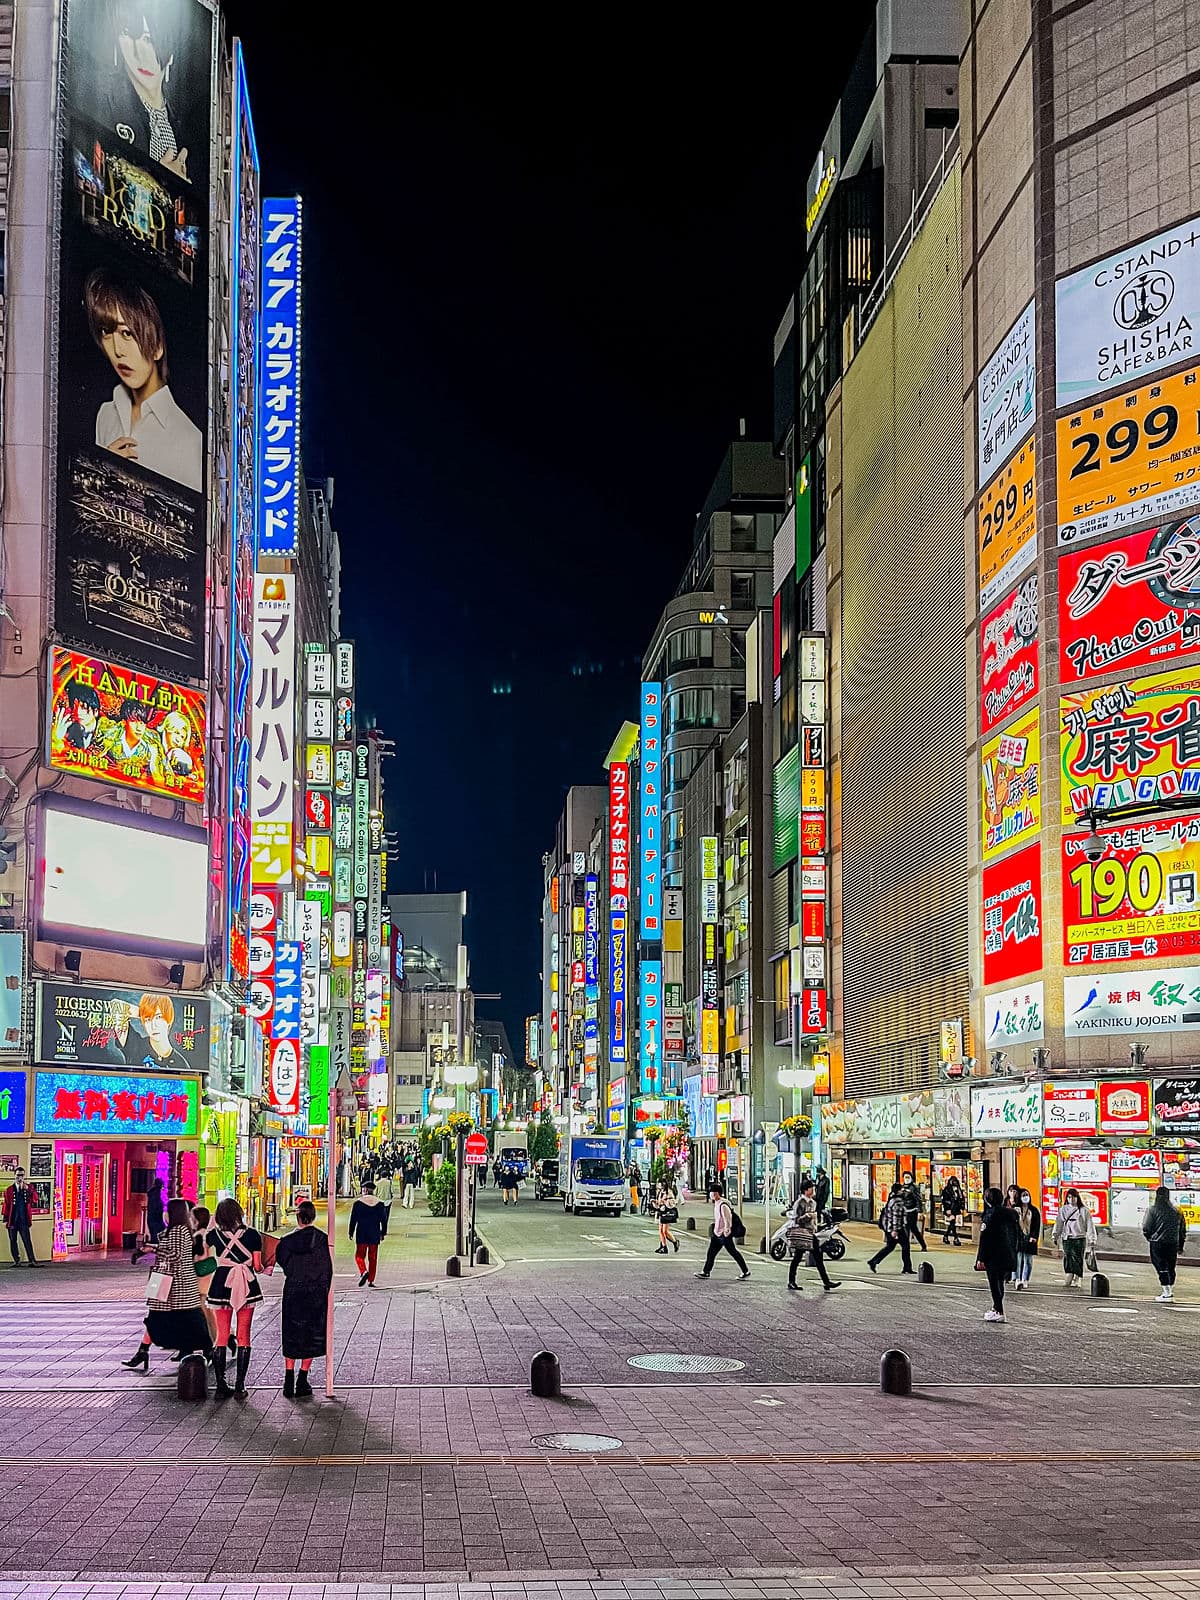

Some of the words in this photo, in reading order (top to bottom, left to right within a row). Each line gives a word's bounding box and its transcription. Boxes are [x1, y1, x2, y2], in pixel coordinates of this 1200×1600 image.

[265, 213, 295, 309] 747
[1097, 335, 1193, 382] CAFE&BAR
[1098, 315, 1193, 366] SHISHA
[982, 377, 1024, 441] シーシャ
[263, 322, 294, 538] カラオケランド
[1069, 404, 1179, 482] 299
[1073, 494, 1117, 516] 生ビール
[1128, 481, 1162, 497] サワー
[1113, 504, 1153, 524] 九十九
[254, 613, 291, 818] マルハン
[313, 700, 325, 736] にいむら
[1062, 683, 1137, 738] フリー&セット
[810, 728, 821, 759] ダーツ
[809, 770, 818, 804] 299円
[1007, 765, 1038, 807] 麻雀
[611, 767, 627, 890] カラオケ歌広場
[645, 693, 657, 930] カラオケ&パーティー館
[804, 823, 822, 850] 麻雀
[1070, 852, 1162, 918] 190
[1169, 872, 1195, 905] 円
[1127, 918, 1165, 934] 当日入会
[1070, 947, 1087, 961] 2F
[1092, 938, 1157, 959] 居酒屋一休
[274, 943, 300, 1038] カラオケ
[1108, 990, 1141, 1004] 焼肉
[183, 1004, 195, 1030] 山田
[1075, 1017, 1133, 1029] YAKINIKU
[1135, 1015, 1177, 1027] JOJOEN
[54, 1088, 189, 1123] 無料案内所
[1003, 1094, 1041, 1124] 叙々苑
